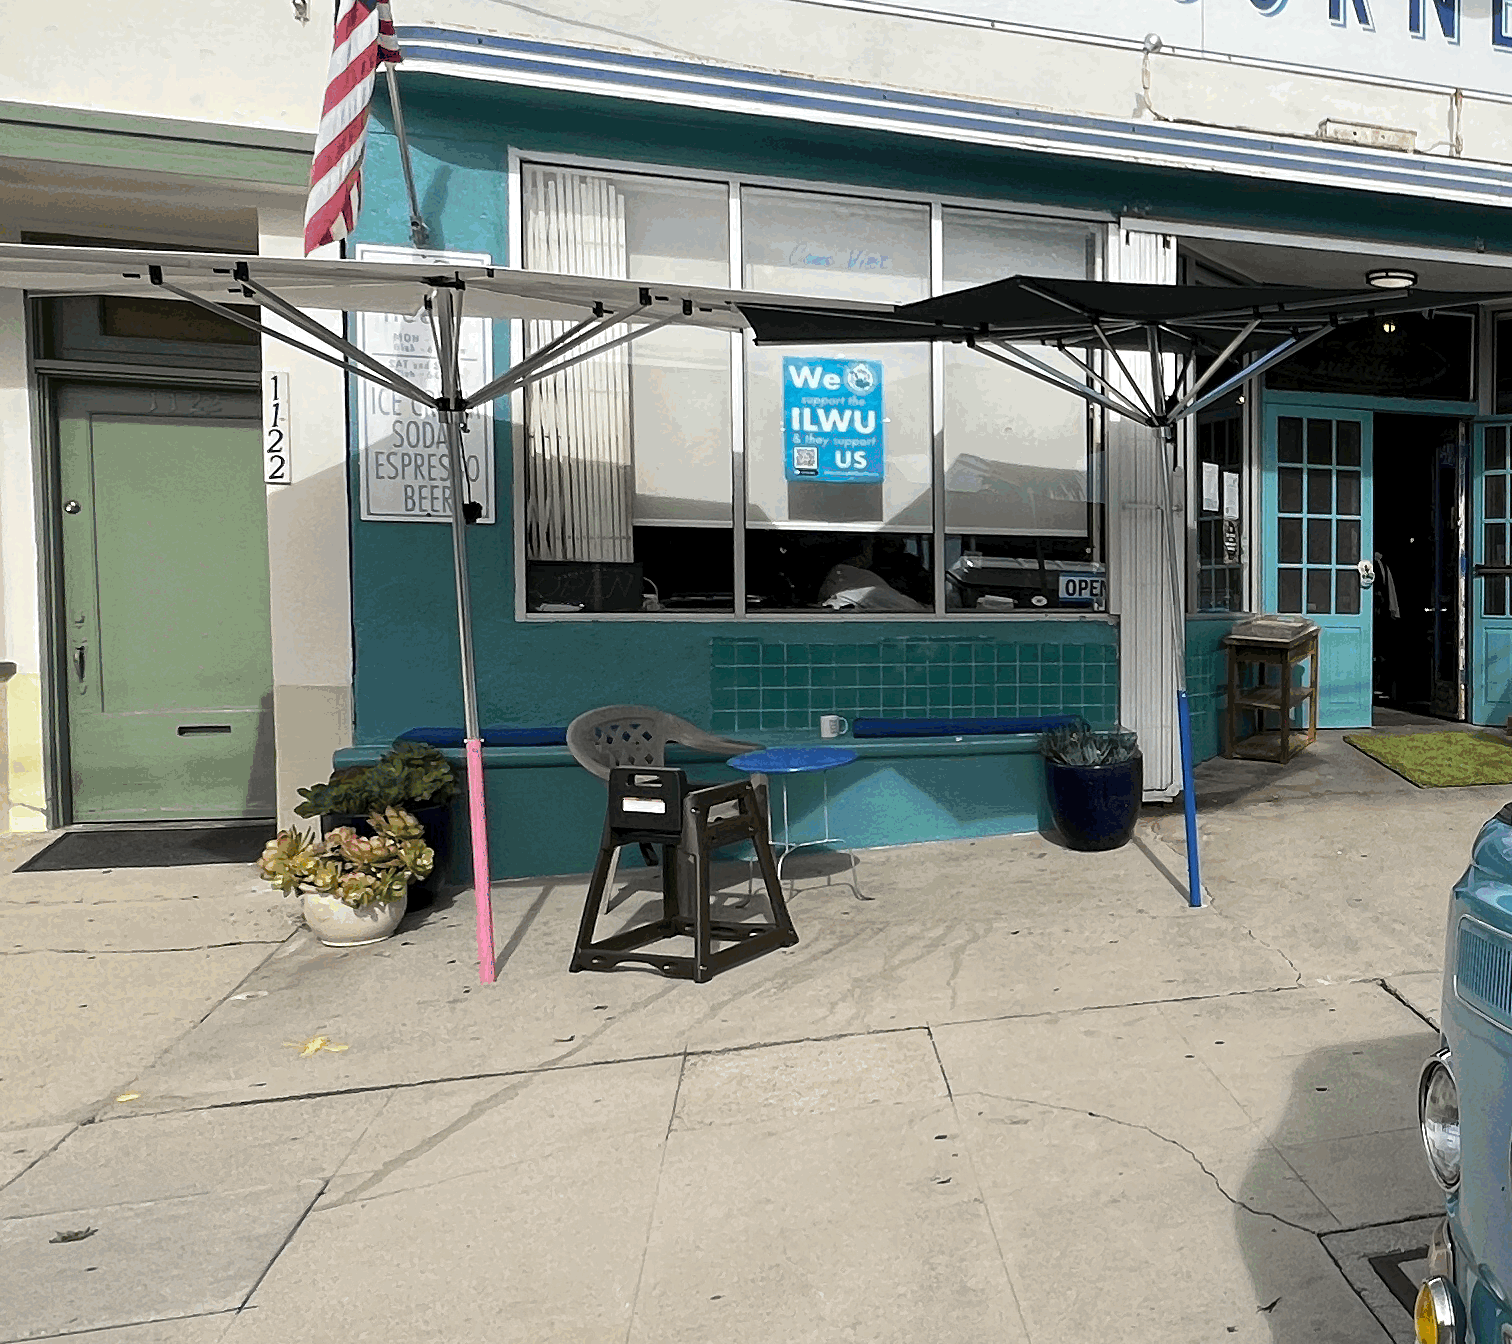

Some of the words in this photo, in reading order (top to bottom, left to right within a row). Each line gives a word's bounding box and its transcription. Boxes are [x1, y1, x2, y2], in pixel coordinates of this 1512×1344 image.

[788, 365, 841, 391] We
[371, 386, 403, 416] ICE
[801, 396, 846, 407] support
[847, 396, 867, 406] the
[266, 375, 286, 480] 1122
[791, 407, 876, 434] ILWU
[392, 420, 449, 449] SODA
[792, 433, 801, 444] &
[805, 433, 829, 447] they
[833, 436, 877, 448] support
[374, 451, 480, 483] ESPRESO
[835, 450, 868, 470] US
